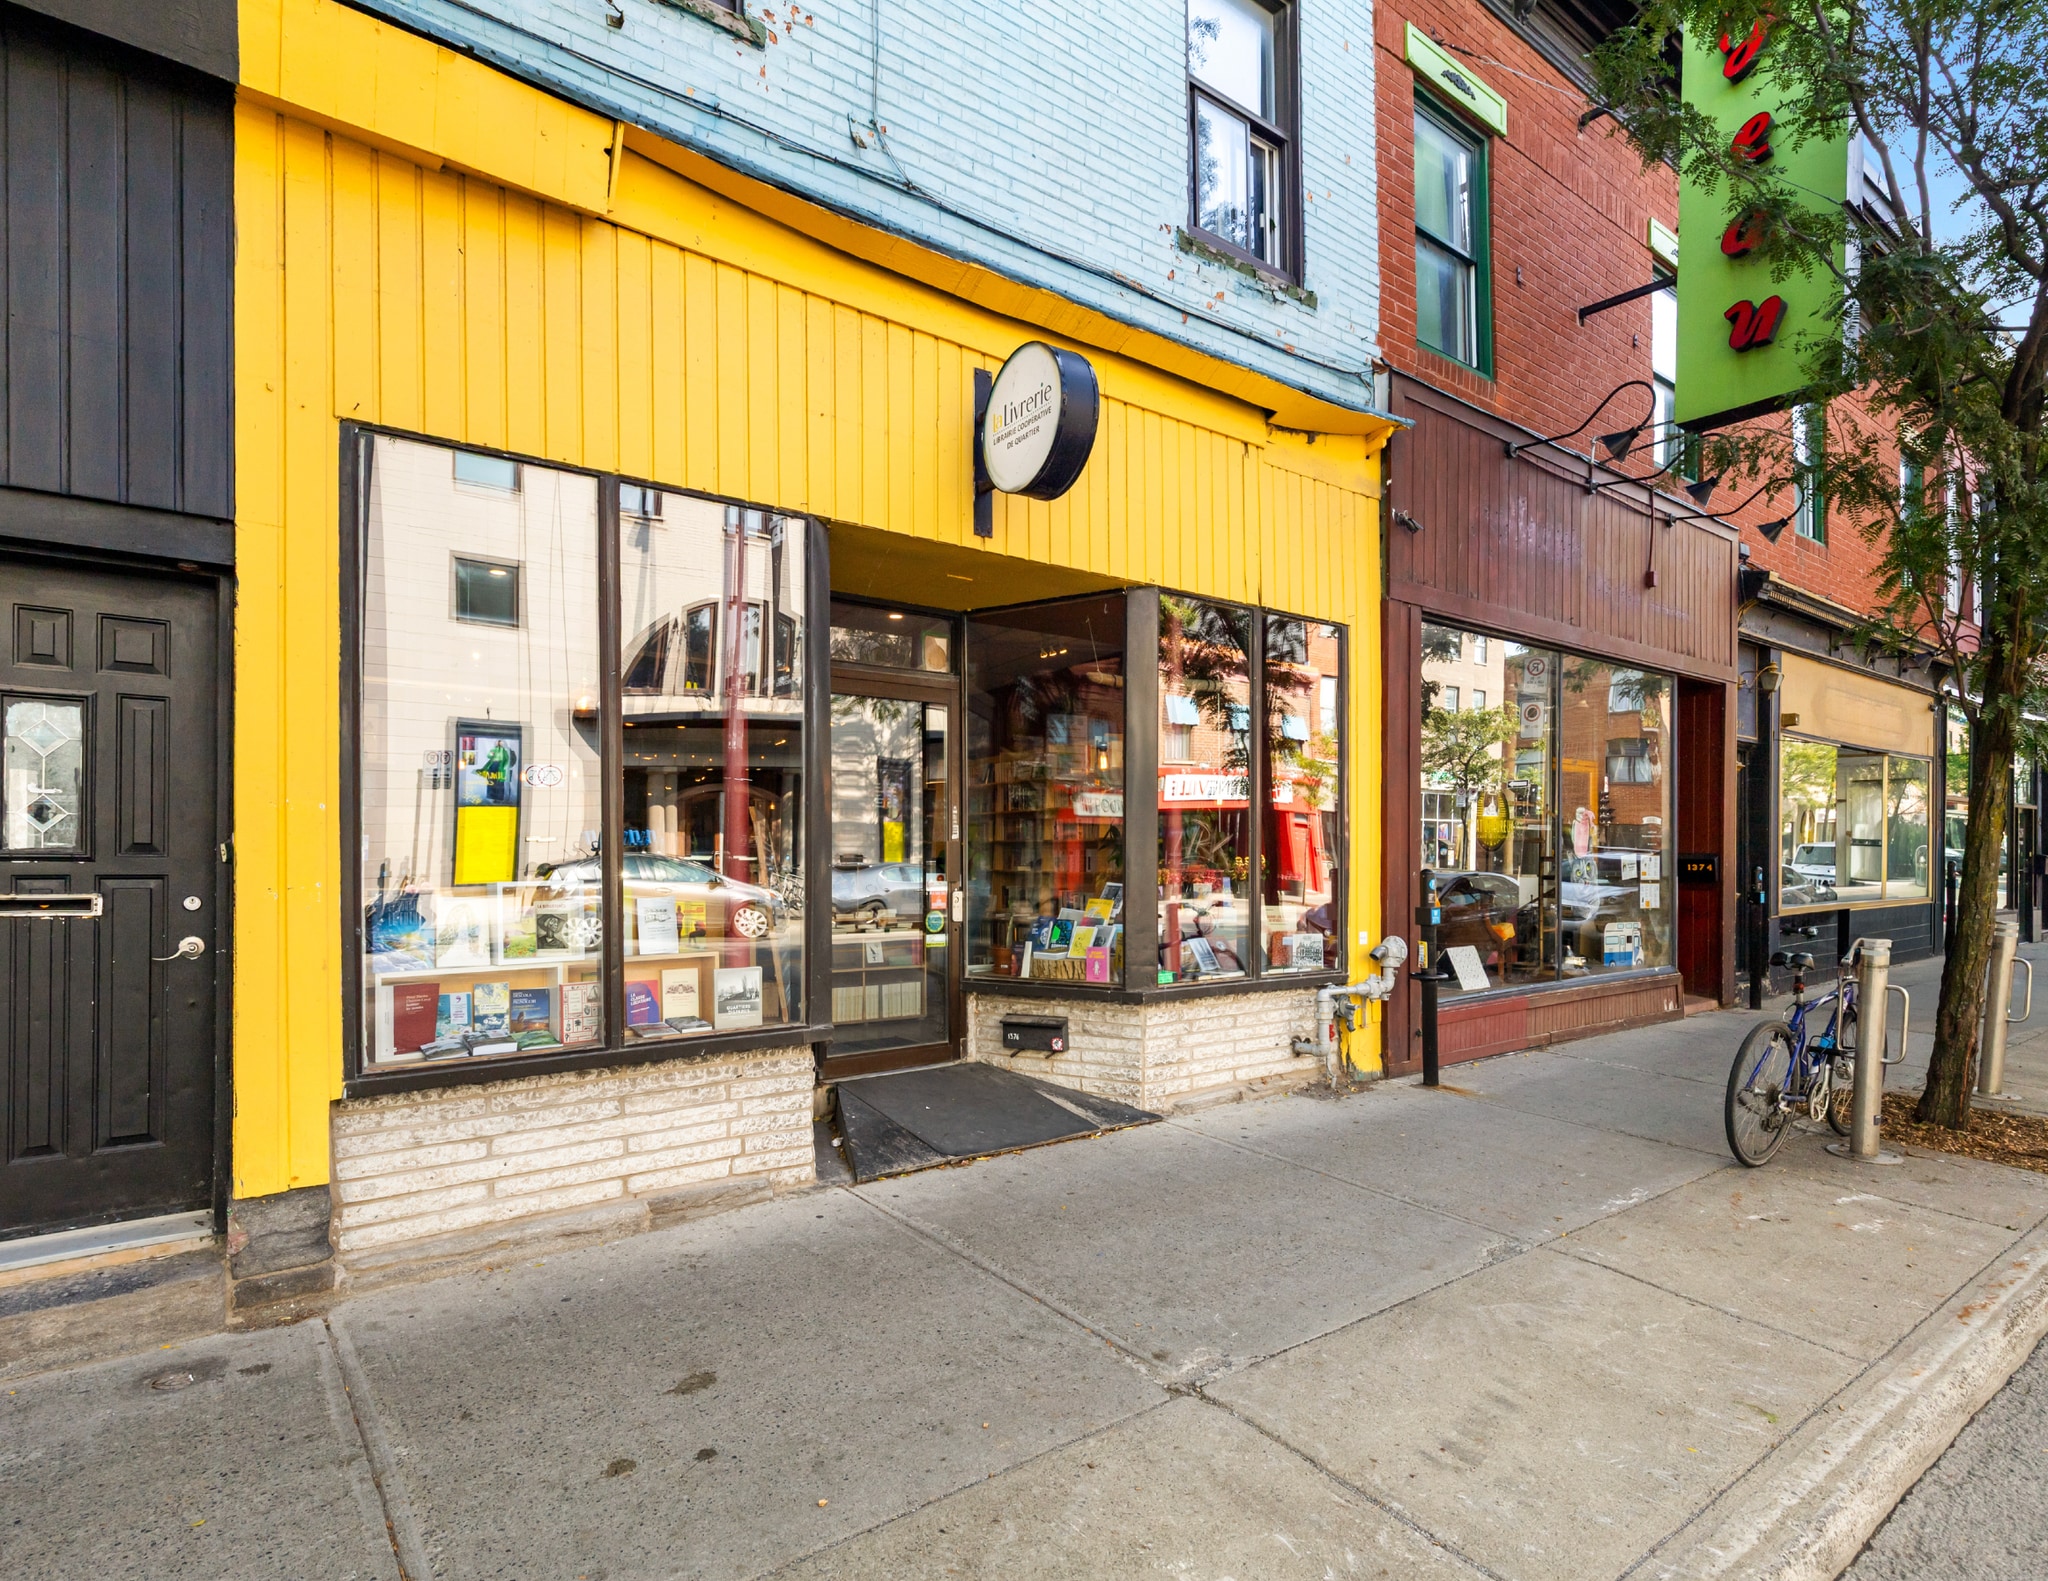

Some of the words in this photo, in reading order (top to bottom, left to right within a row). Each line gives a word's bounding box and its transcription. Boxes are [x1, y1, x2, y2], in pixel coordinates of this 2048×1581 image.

[993, 426, 1017, 446] LIBRAIRIE
[1006, 439, 1014, 450] DE
[1014, 425, 1040, 445] QUARTIER
[1687, 863, 1713, 872] 1374
[1007, 1032, 1020, 1041] 1376
